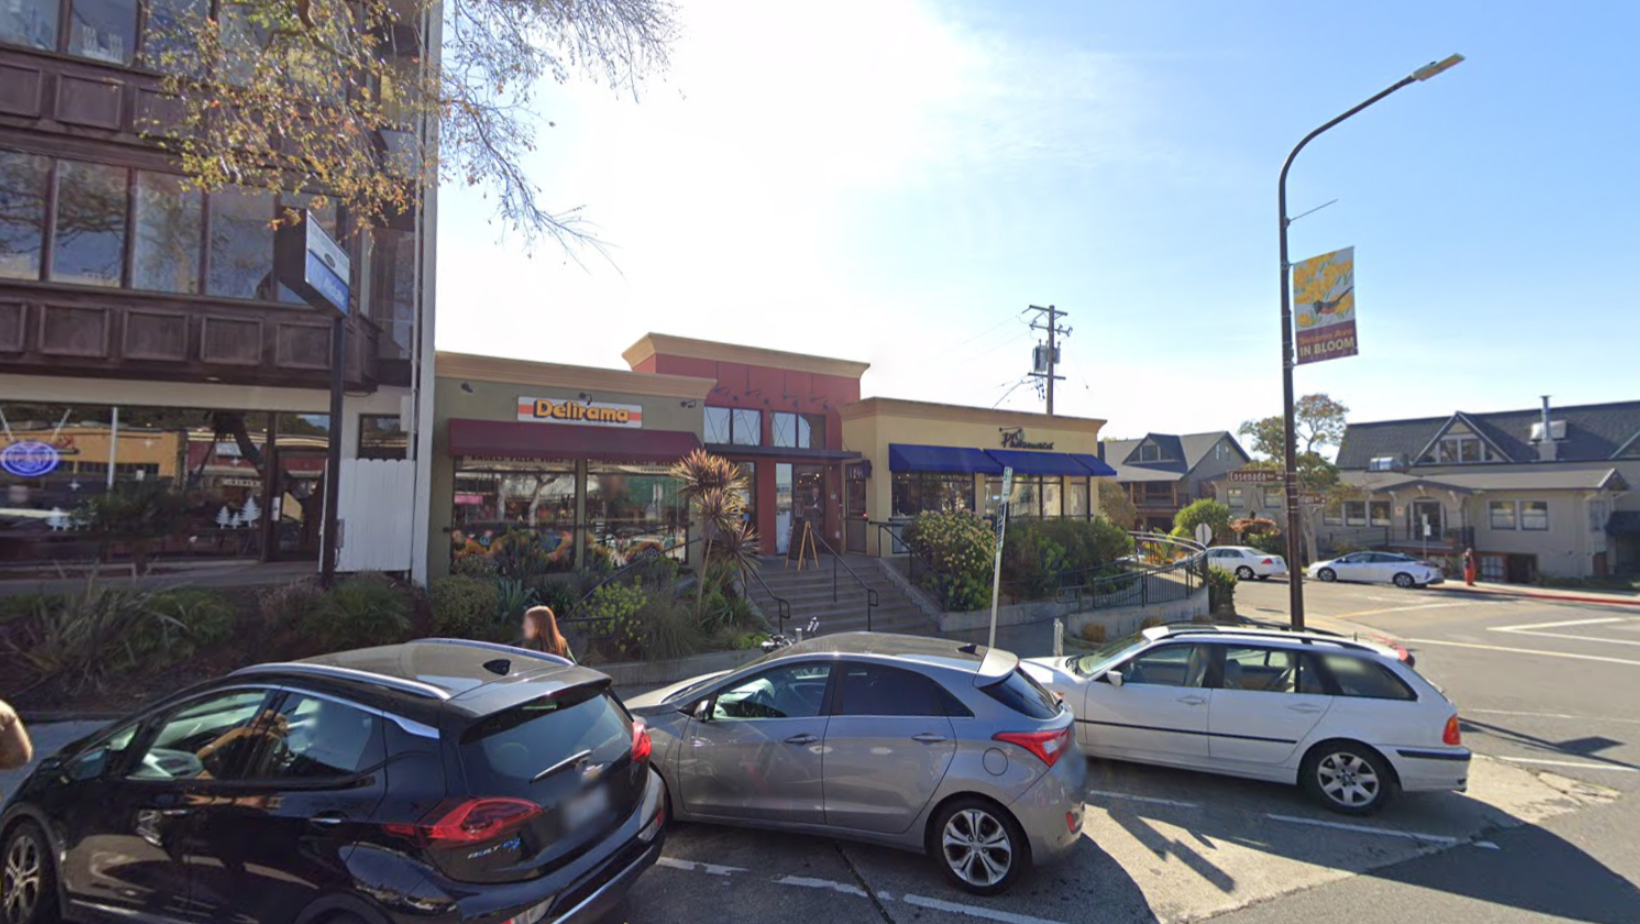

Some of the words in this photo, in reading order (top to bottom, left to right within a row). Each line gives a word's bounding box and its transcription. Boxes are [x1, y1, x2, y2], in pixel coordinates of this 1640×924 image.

[1300, 345, 1311, 357] IN
[1314, 336, 1354, 354] BLOOM
[533, 399, 629, 423] Delirama
[1229, 471, 1266, 482] Ensenada
